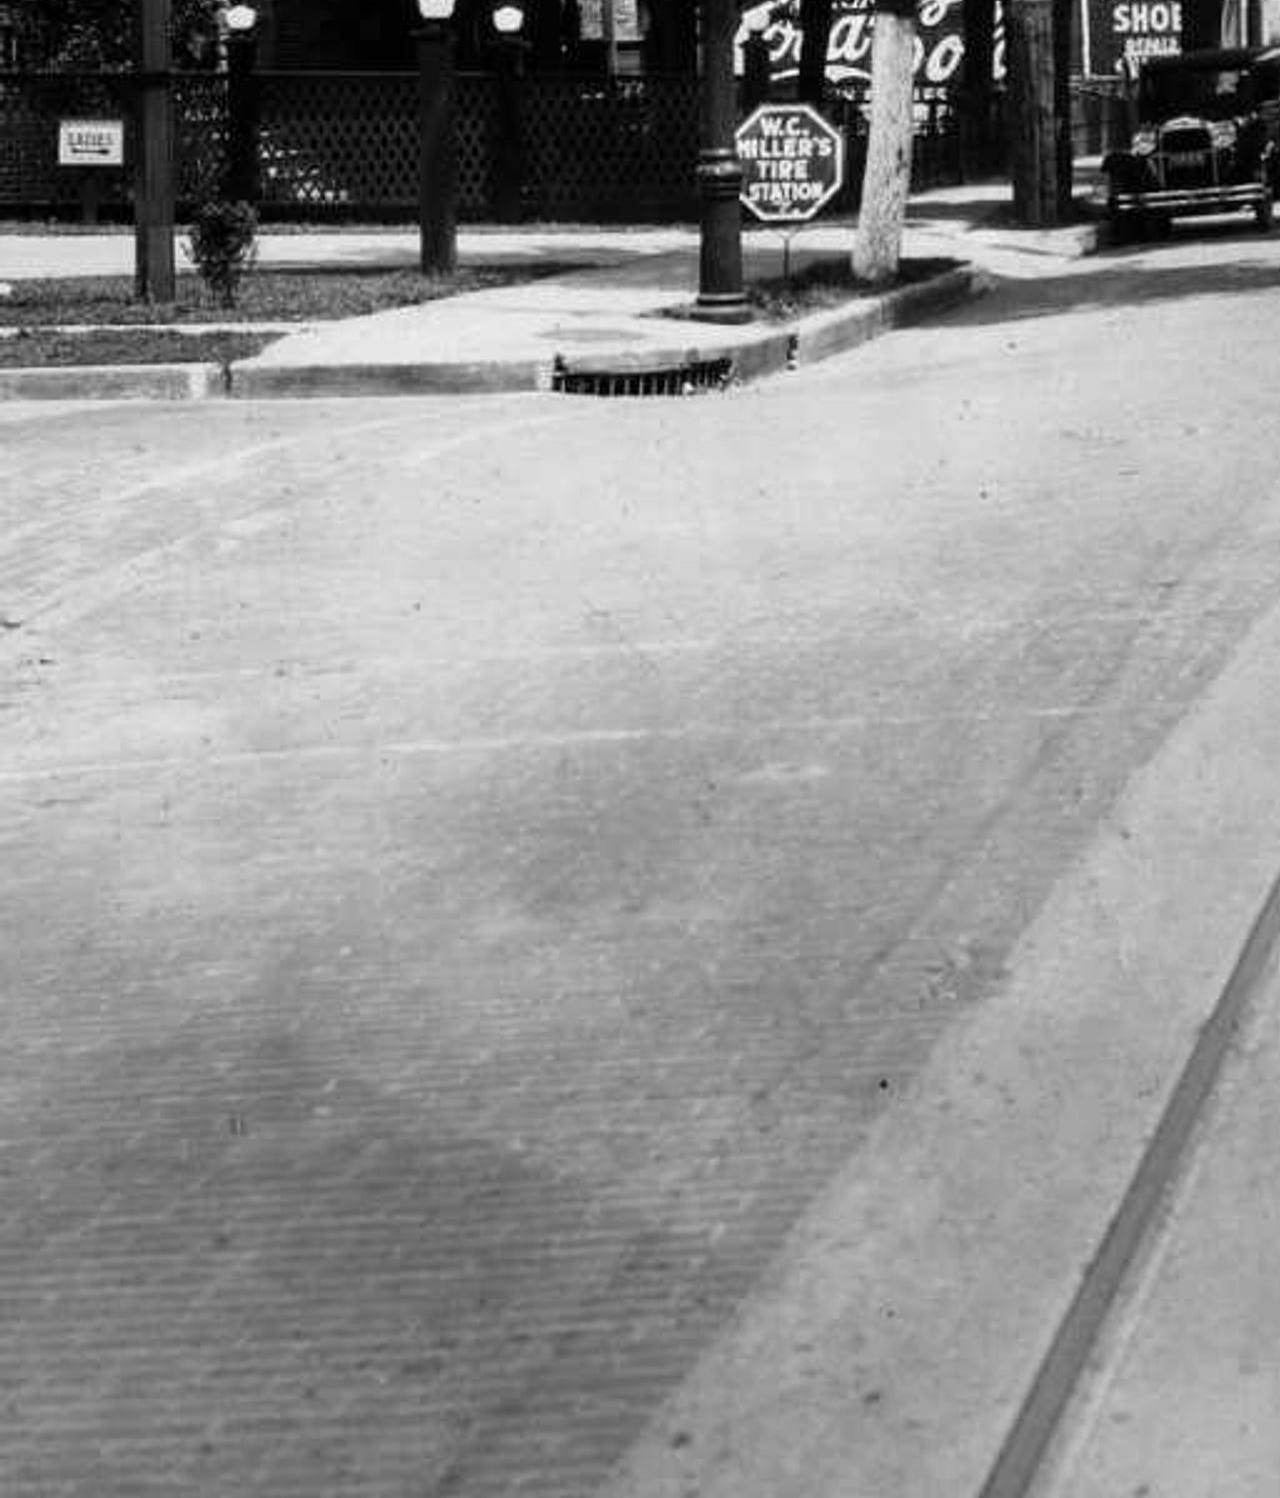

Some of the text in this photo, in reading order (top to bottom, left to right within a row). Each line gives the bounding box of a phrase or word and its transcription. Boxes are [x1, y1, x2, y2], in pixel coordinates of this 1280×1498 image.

[1112, 3, 1182, 33] SHOE
[736, 137, 833, 159] MILLER'S
[756, 160, 808, 180] TIRE
[748, 181, 824, 202] STATION
